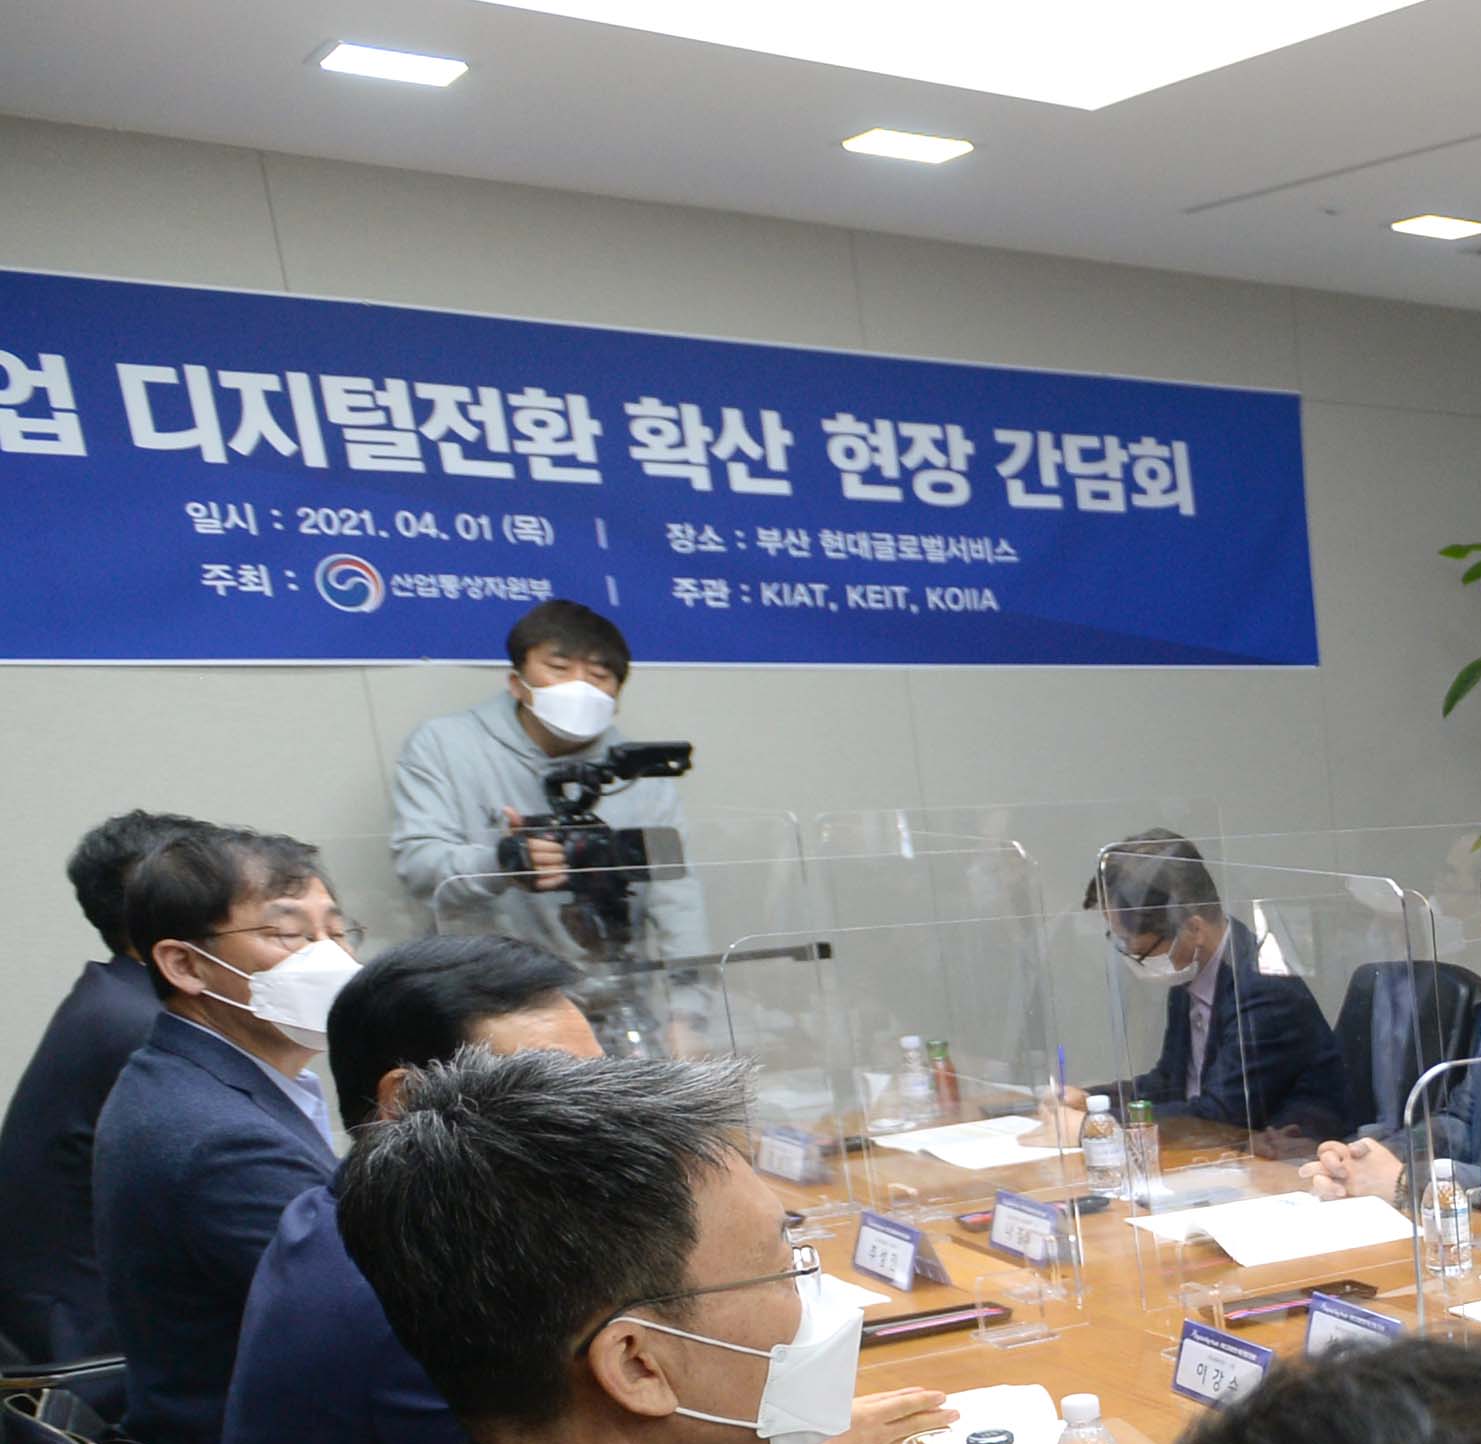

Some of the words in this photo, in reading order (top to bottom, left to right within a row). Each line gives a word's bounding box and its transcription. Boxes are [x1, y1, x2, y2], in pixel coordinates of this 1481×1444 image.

[116, 363, 603, 484] 디지털전환
[623, 396, 794, 496] 확산
[821, 412, 975, 507] 현장
[993, 428, 1196, 516] 간담회
[185, 501, 259, 536] 일시
[296, 506, 389, 538] 2021.
[394, 510, 450, 541] 04.
[454, 513, 493, 541] 01
[502, 514, 555, 547] (목)
[666, 522, 727, 554] 장소
[756, 527, 812, 558] 부산
[817, 528, 1019, 564] 현대글로벌서비스
[201, 563, 273, 597] 주최
[389, 573, 553, 602] 산업통상자원부
[671, 577, 731, 609] 주관
[759, 581, 839, 612] KIAT,
[845, 584, 919, 614] KEIT,
[925, 586, 1000, 612] KOIIA
